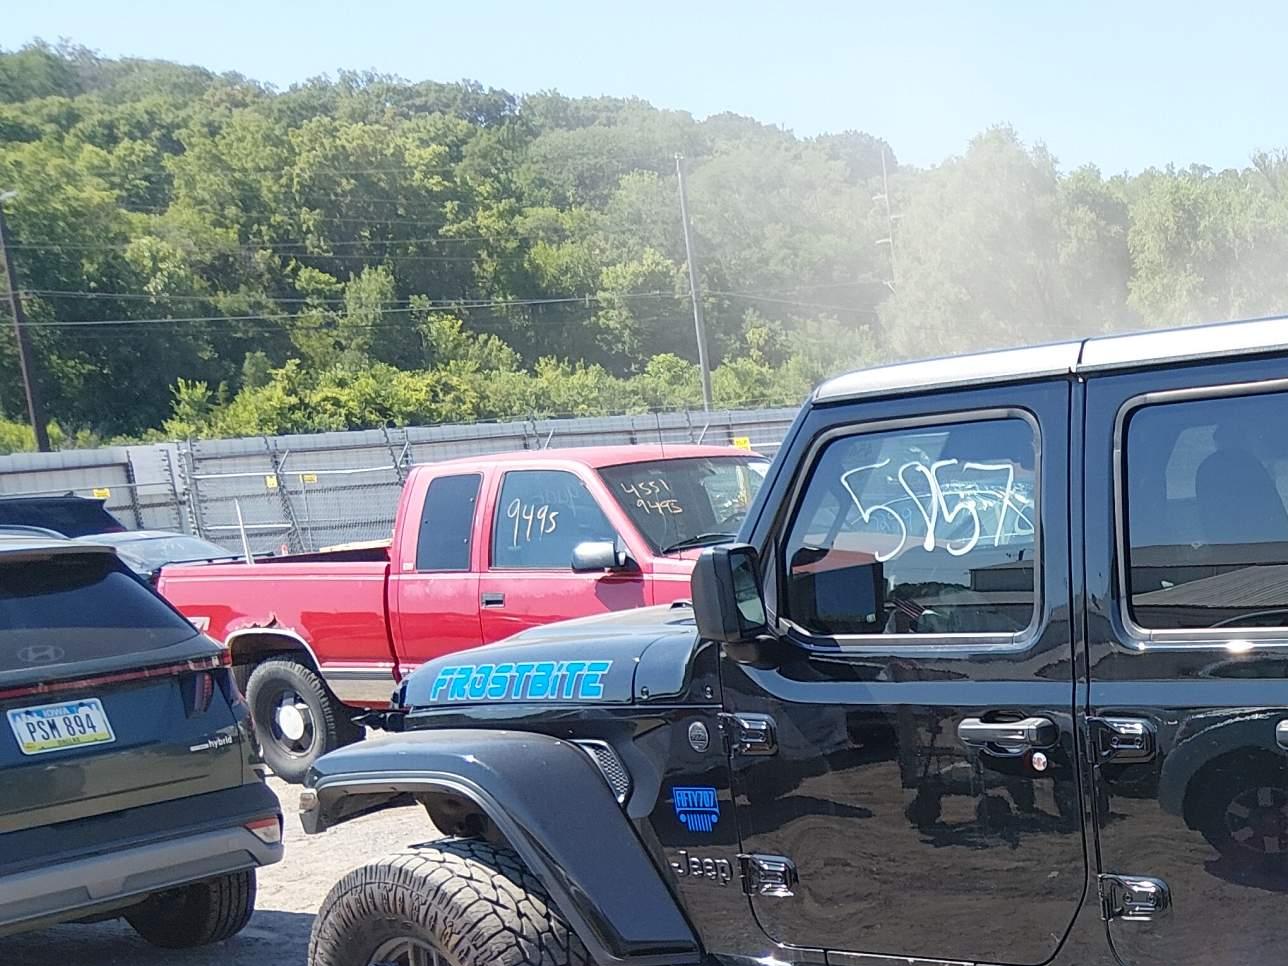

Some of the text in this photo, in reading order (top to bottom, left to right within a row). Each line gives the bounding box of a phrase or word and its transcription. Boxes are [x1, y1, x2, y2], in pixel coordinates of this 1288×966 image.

[621, 480, 669, 498] 4551
[636, 500, 683, 515] 9495
[507, 499, 559, 547] 9495
[25, 713, 97, 742] PSM 894
[208, 735, 232, 749] hybrid
[671, 850, 733, 887] Jeep
